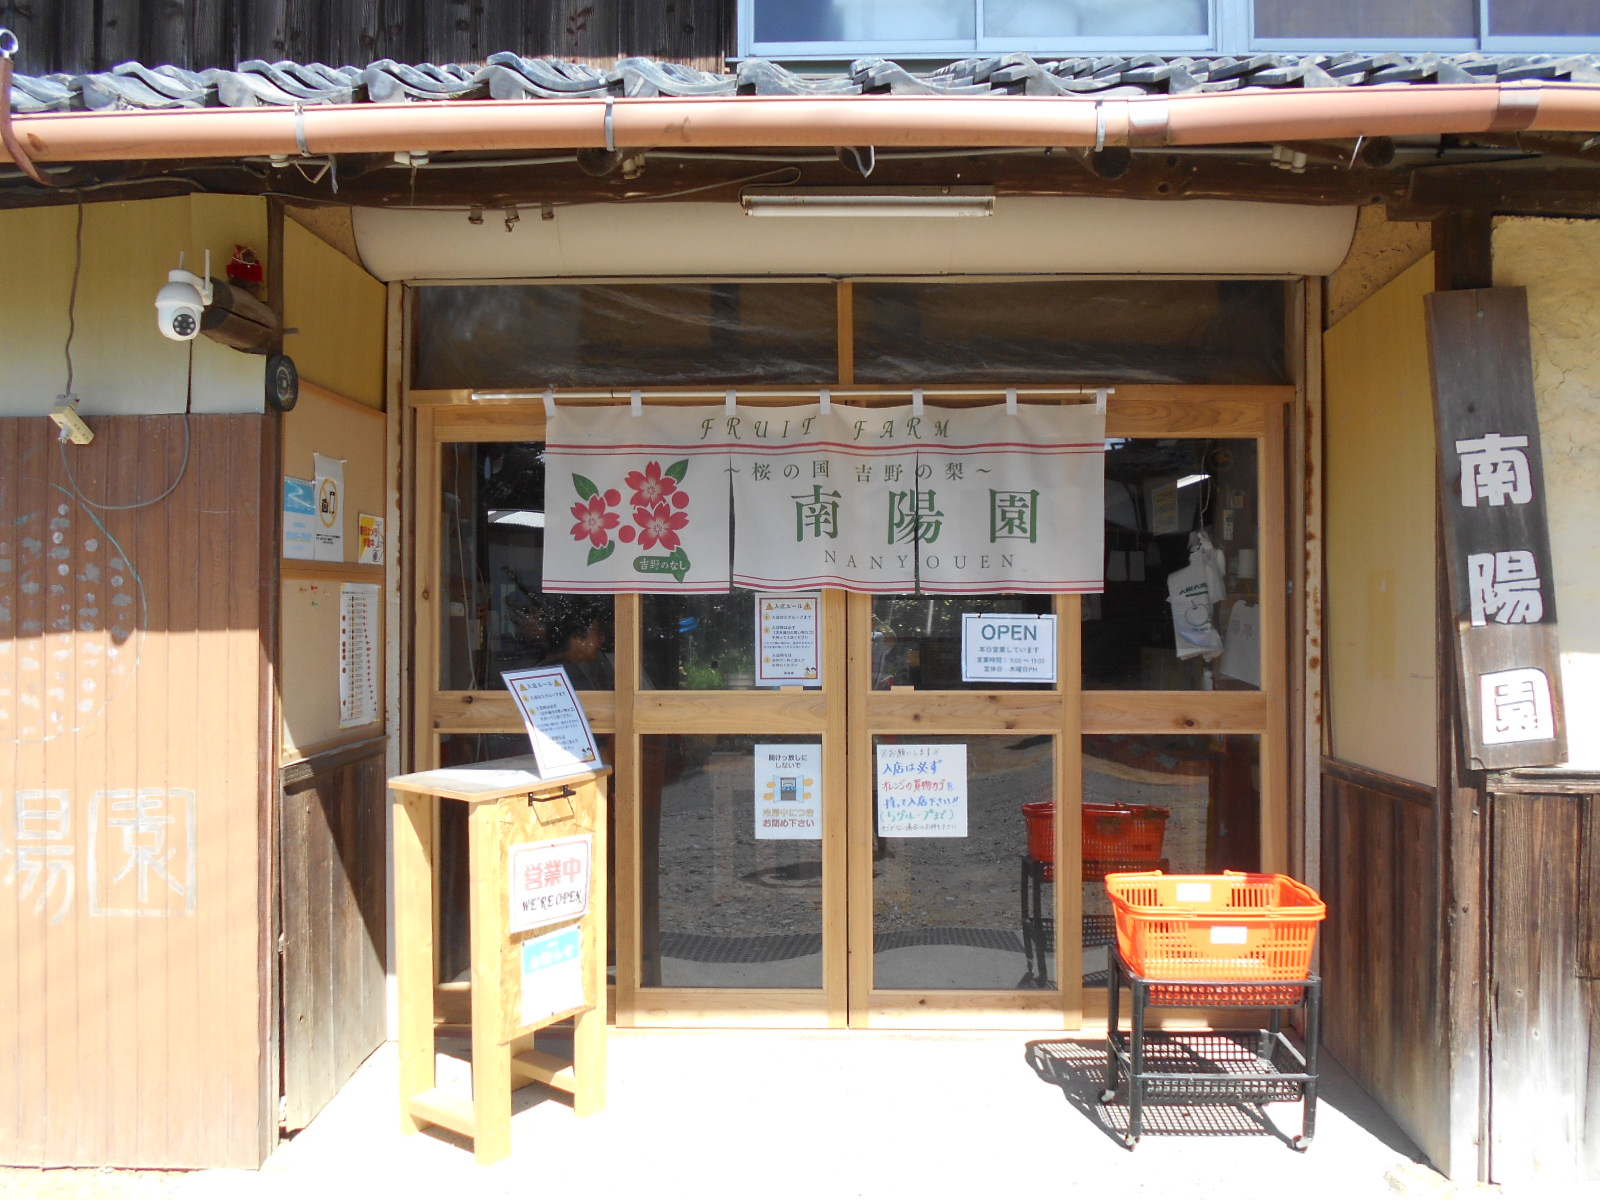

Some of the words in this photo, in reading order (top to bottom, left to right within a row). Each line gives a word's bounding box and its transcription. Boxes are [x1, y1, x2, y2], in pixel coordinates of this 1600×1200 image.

[700, 415, 817, 440] FRUIT
[853, 416, 950, 440] FARM
[791, 484, 1039, 545] 南陽園
[640, 558, 686, 571] 吉野のなし
[824, 549, 1016, 569] NANYOUEN
[1455, 433, 1556, 746] 南陽園
[981, 624, 1037, 641] OPEN
[882, 759, 942, 775] 入店は必ず
[524, 857, 582, 891] 営業中
[555, 889, 584, 907] OPEN
